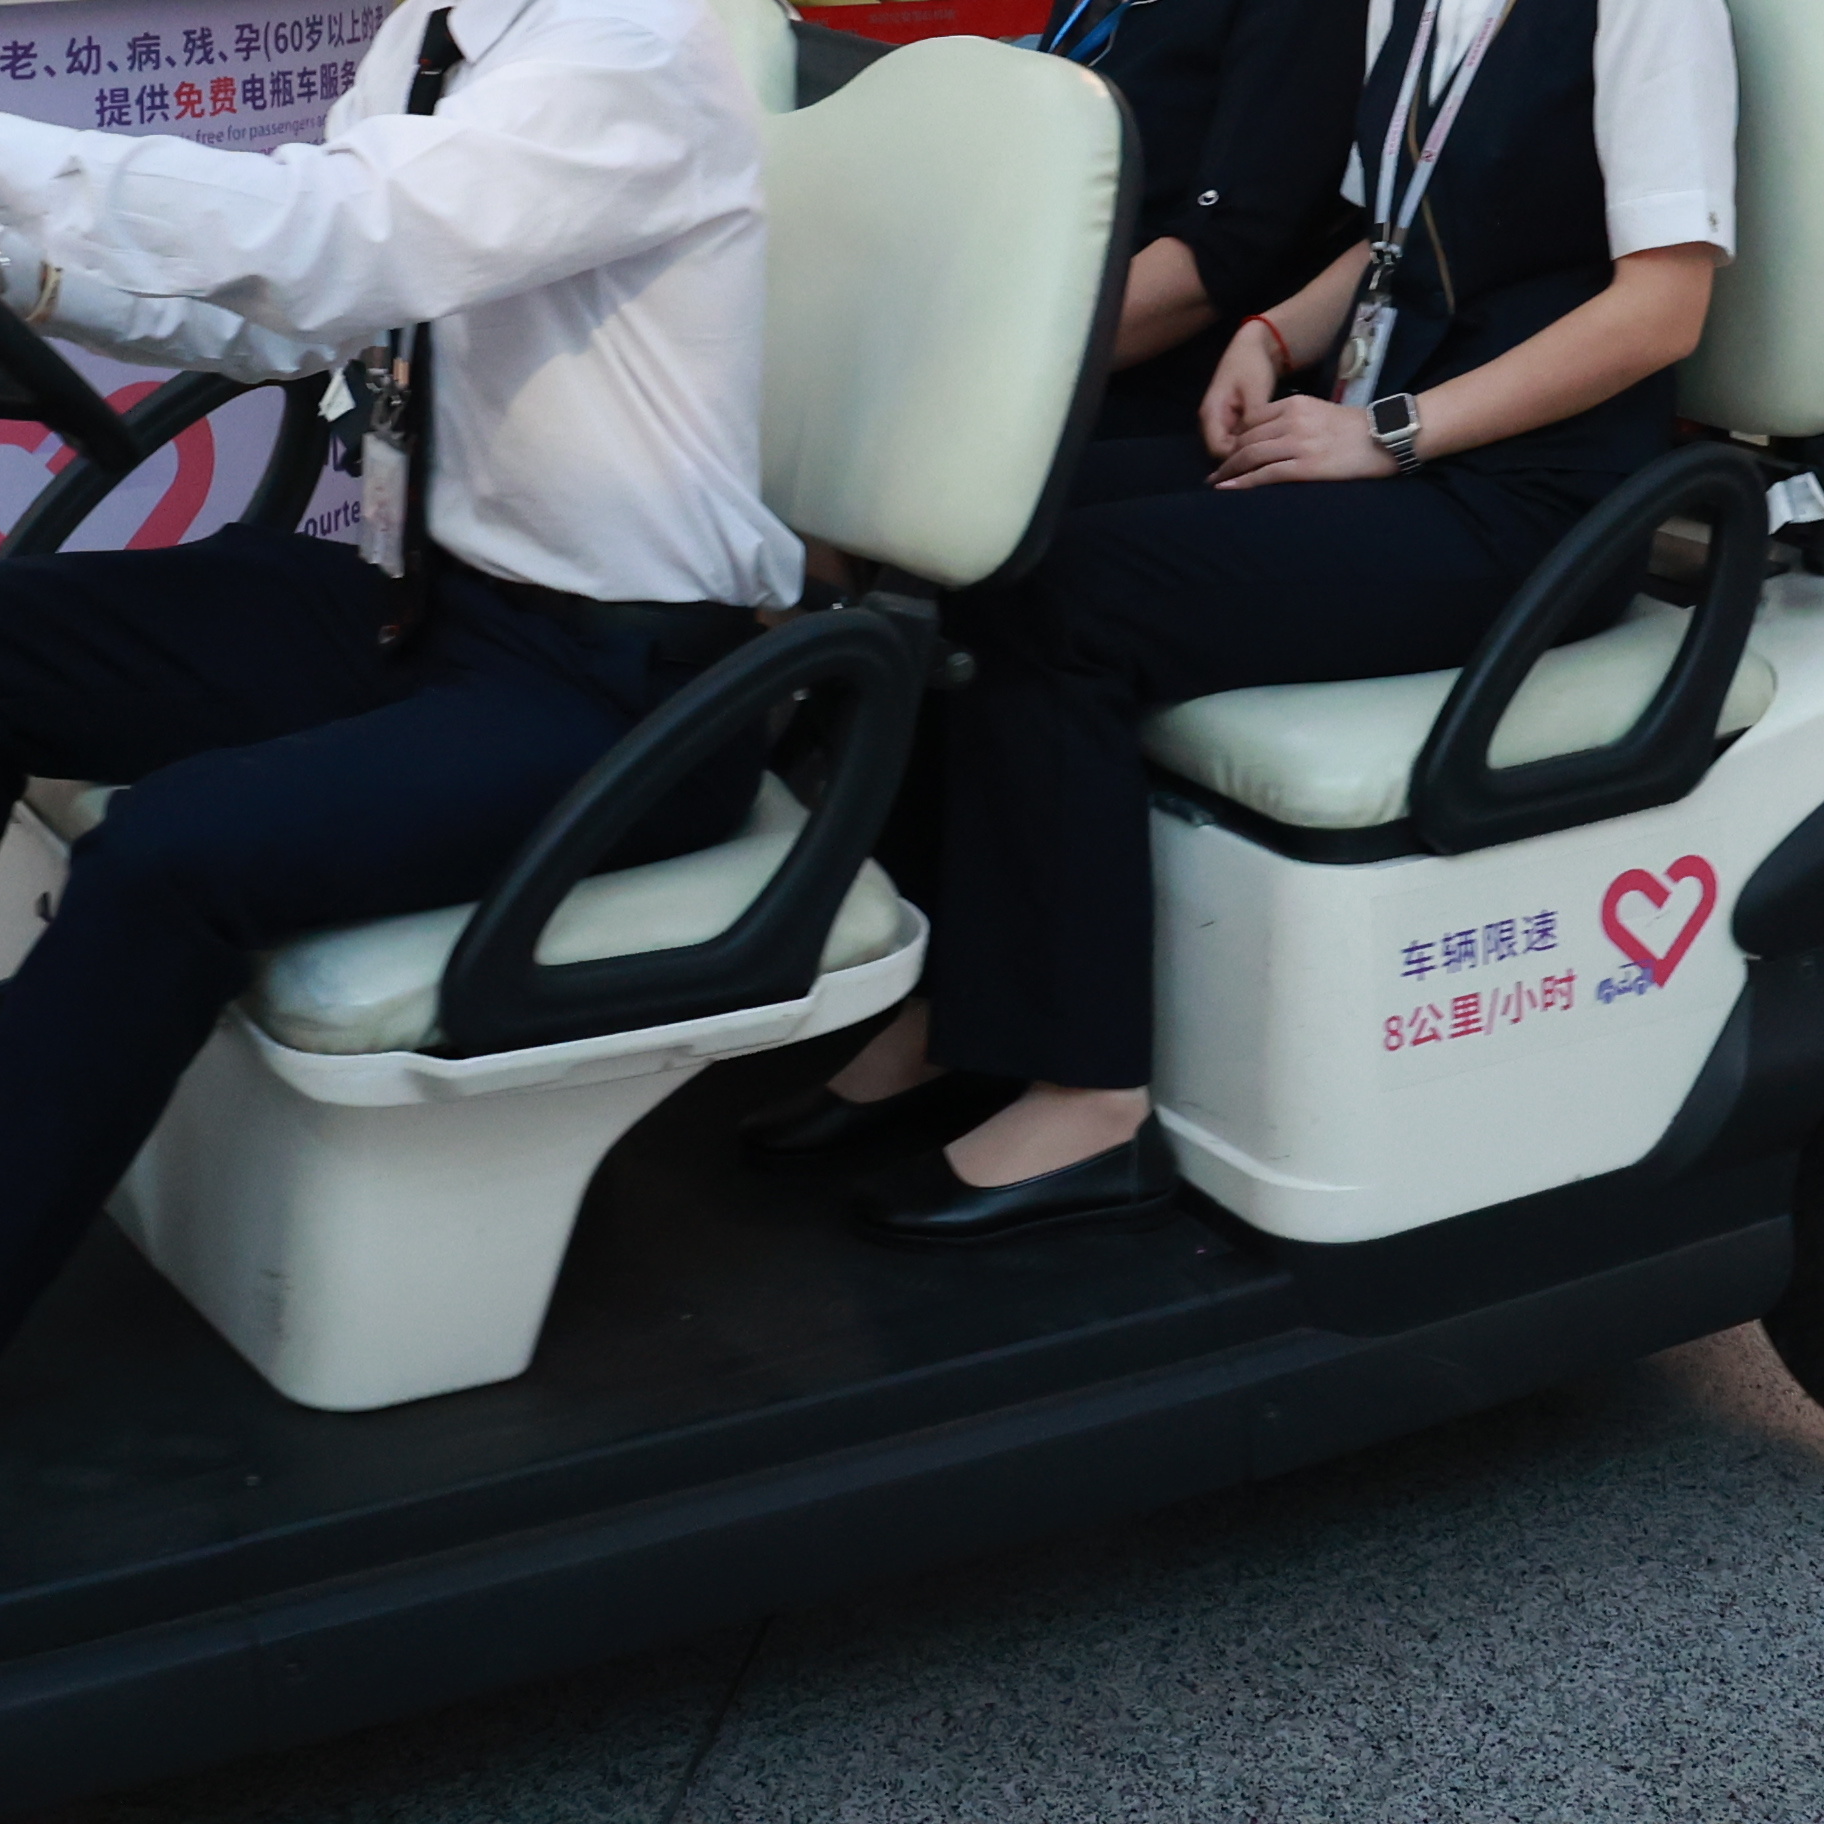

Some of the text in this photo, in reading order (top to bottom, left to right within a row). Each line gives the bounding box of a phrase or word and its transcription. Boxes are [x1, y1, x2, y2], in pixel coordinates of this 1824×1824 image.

[95, 59, 356, 129] 提供免费电瓶车服务
[195, 129, 224, 144] free
[228, 124, 248, 142] for
[250, 117, 315, 141] passengers
[304, 500, 361, 537] ourte
[1399, 909, 1559, 981] 车辆限速
[1382, 969, 1578, 1052] 8公里/小时
